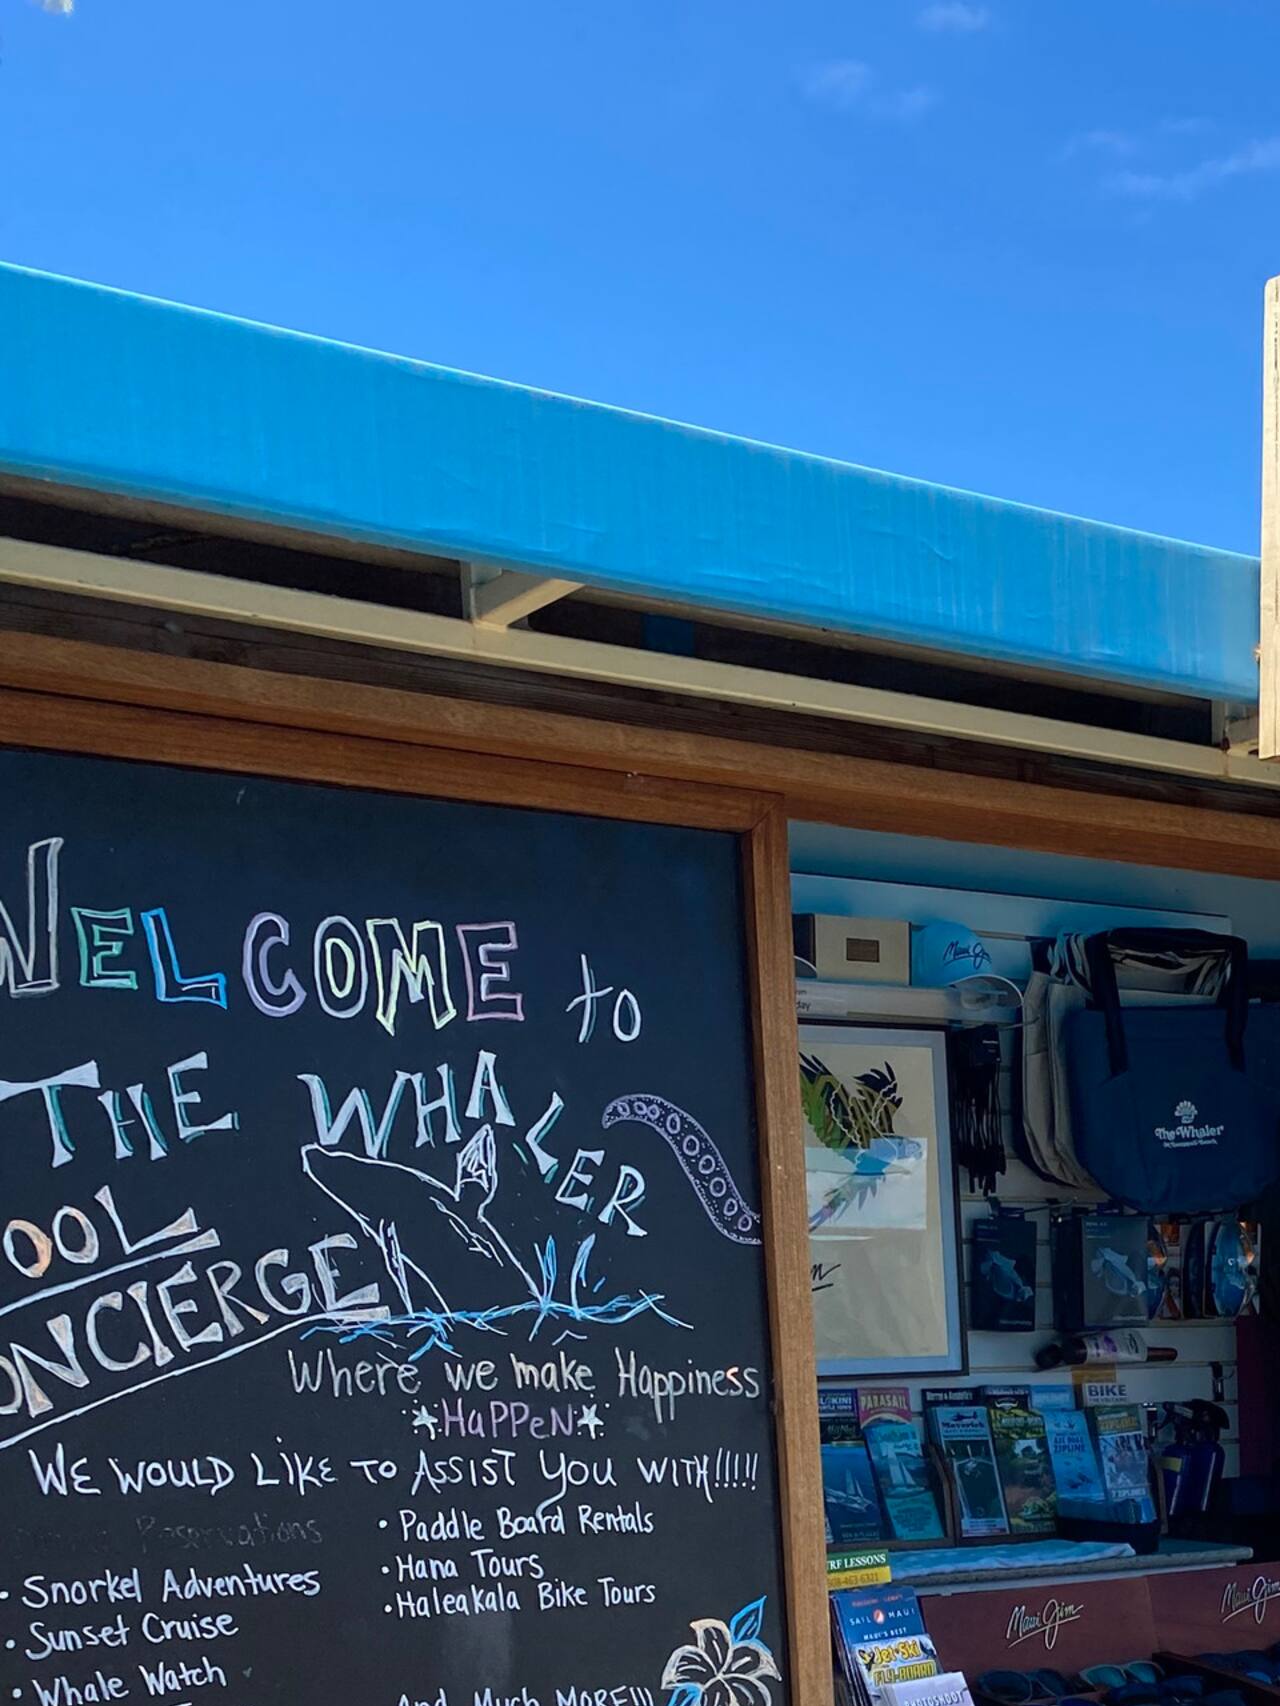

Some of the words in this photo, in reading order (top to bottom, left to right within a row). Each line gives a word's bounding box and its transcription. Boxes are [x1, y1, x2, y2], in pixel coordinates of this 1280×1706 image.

[566, 955, 642, 1042] to
[0, 1052, 239, 1167] THE
[297, 1050, 648, 1236] WHALER
[1154, 1126, 1176, 1141] The
[1176, 1124, 1225, 1139] Whaler
[2, 1184, 200, 1279] OOL
[0, 1233, 381, 1418] NCIERGE
[287, 1348, 423, 1398] Where
[445, 1359, 498, 1391] we
[510, 1351, 597, 1392] make
[616, 1347, 761, 1424] Happiness
[860, 1394, 909, 1410] PARASAIL
[1088, 1384, 1128, 1396] BIKE
[29, 1443, 101, 1496] WE
[108, 1456, 234, 1496] WOULD
[350, 1460, 398, 1485] TO
[411, 1449, 516, 1496] ASSIST
[399, 1509, 485, 1543] Paddle
[496, 1505, 565, 1540] Board
[578, 1501, 655, 1534] Rentals
[395, 1553, 458, 1583] Hana
[471, 1548, 545, 1580] Tours
[827, 1559, 842, 1570] RF
[844, 1553, 887, 1568] LESSONS
[22, 1567, 142, 1609] Snorkel
[162, 1563, 321, 1602] Adventures
[537, 1577, 588, 1611] Bike
[597, 1577, 656, 1609] Tours
[1220, 1581, 1252, 1615] Maui
[25, 1614, 130, 1661] Sunset
[142, 1612, 239, 1645] Cruise
[849, 1615, 871, 1626] SAIL
[888, 1607, 916, 1619] MAUI
[1006, 1602, 1041, 1640] Maui
[1042, 1599, 1084, 1650] Jim
[138, 1656, 227, 1696] Watch
